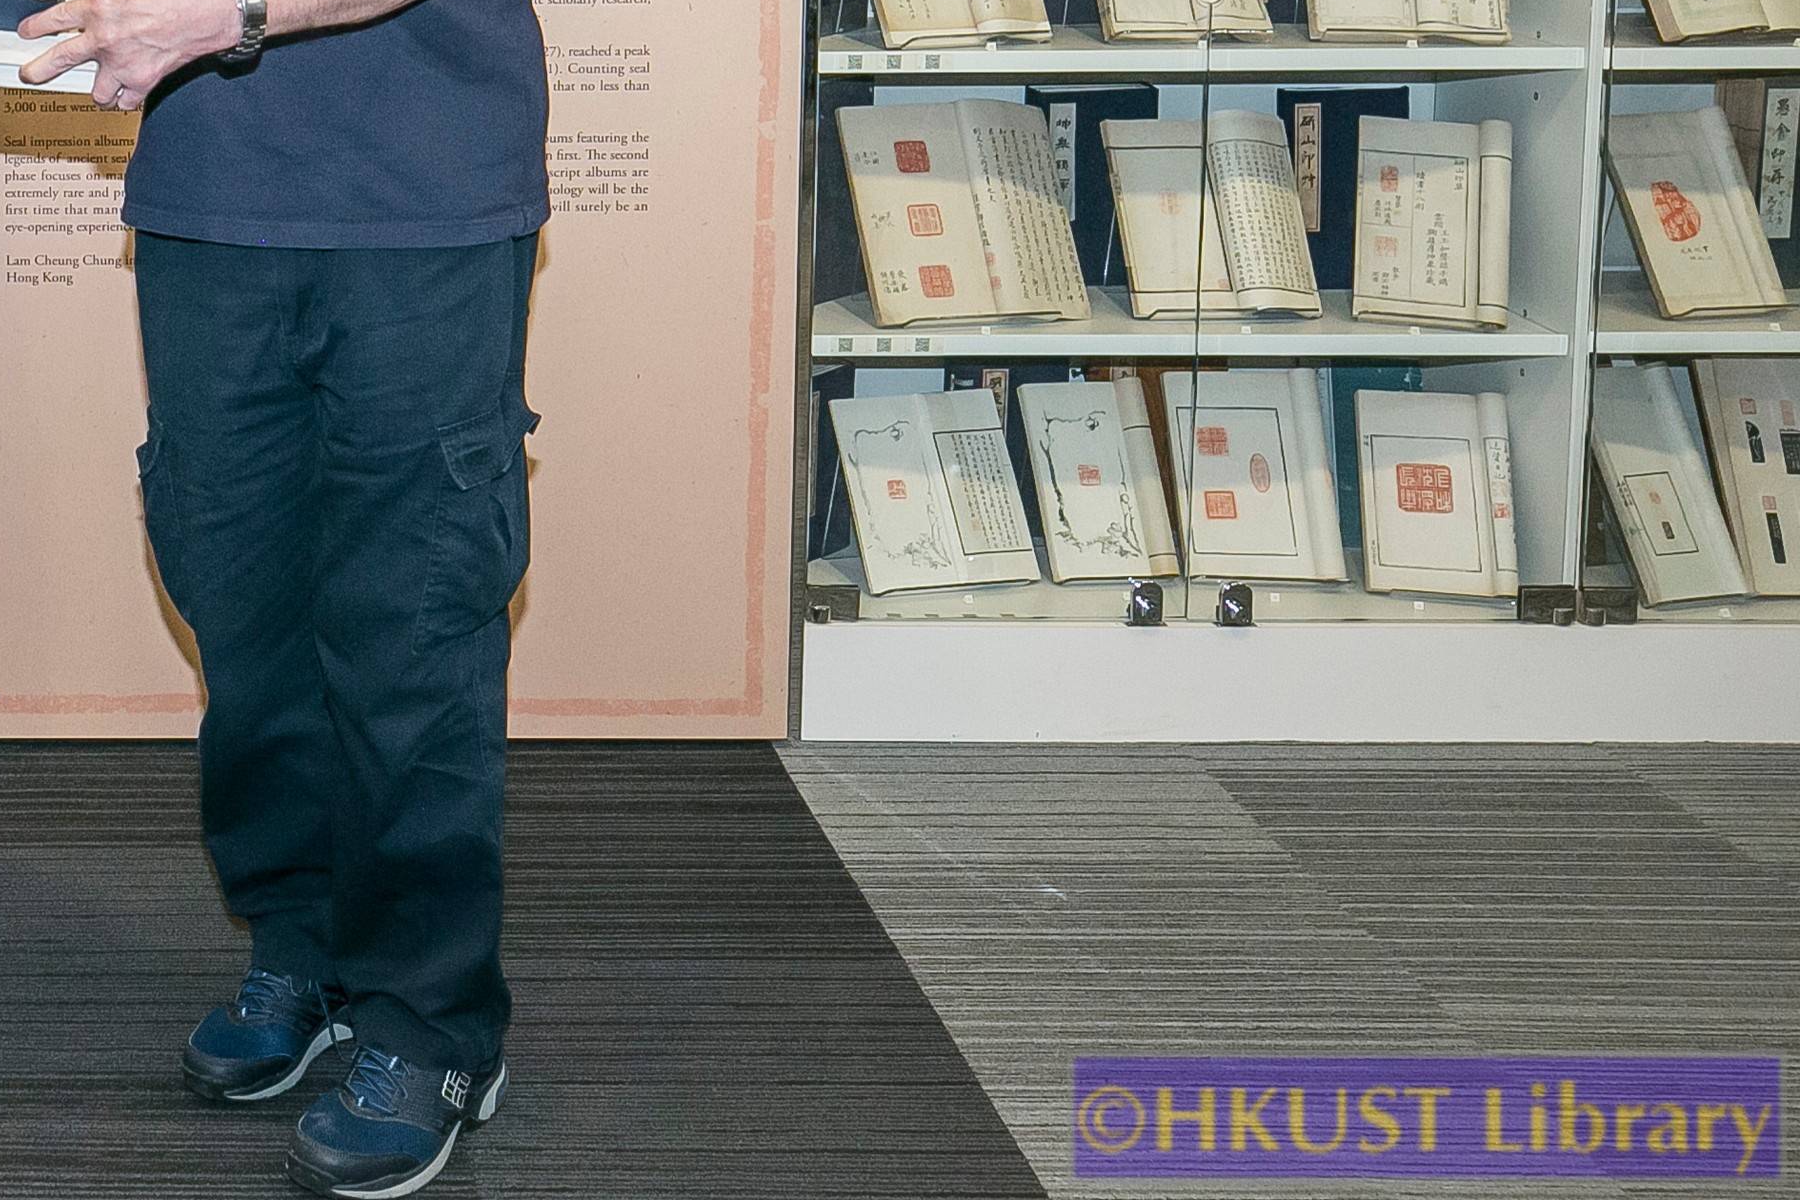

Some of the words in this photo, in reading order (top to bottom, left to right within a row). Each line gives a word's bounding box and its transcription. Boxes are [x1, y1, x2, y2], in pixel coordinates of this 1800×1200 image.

[553, 79, 574, 91] that
[600, 79, 619, 90] less
[624, 79, 649, 90] than
[4, 134, 26, 146] Seal
[30, 135, 90, 149] impression
[94, 134, 134, 145] albums
[4, 152, 45, 167] legends
[48, 152, 61, 163] of
[67, 152, 107, 163] ancient
[4, 169, 36, 184] phase
[40, 168, 81, 180] focuses
[4, 186, 58, 201] extremely
[63, 189, 84, 197] rare
[88, 186, 108, 197] and
[588, 183, 608, 194] will
[613, 182, 626, 194] be
[630, 182, 648, 193] the
[5, 203, 27, 214] first
[33, 204, 59, 214] time
[64, 203, 87, 214] that
[6, 254, 30, 265] Lam
[34, 254, 79, 269] Cheung
[82, 254, 121, 269] Chung
[6, 271, 38, 286] Hong
[42, 271, 73, 286] Kong
